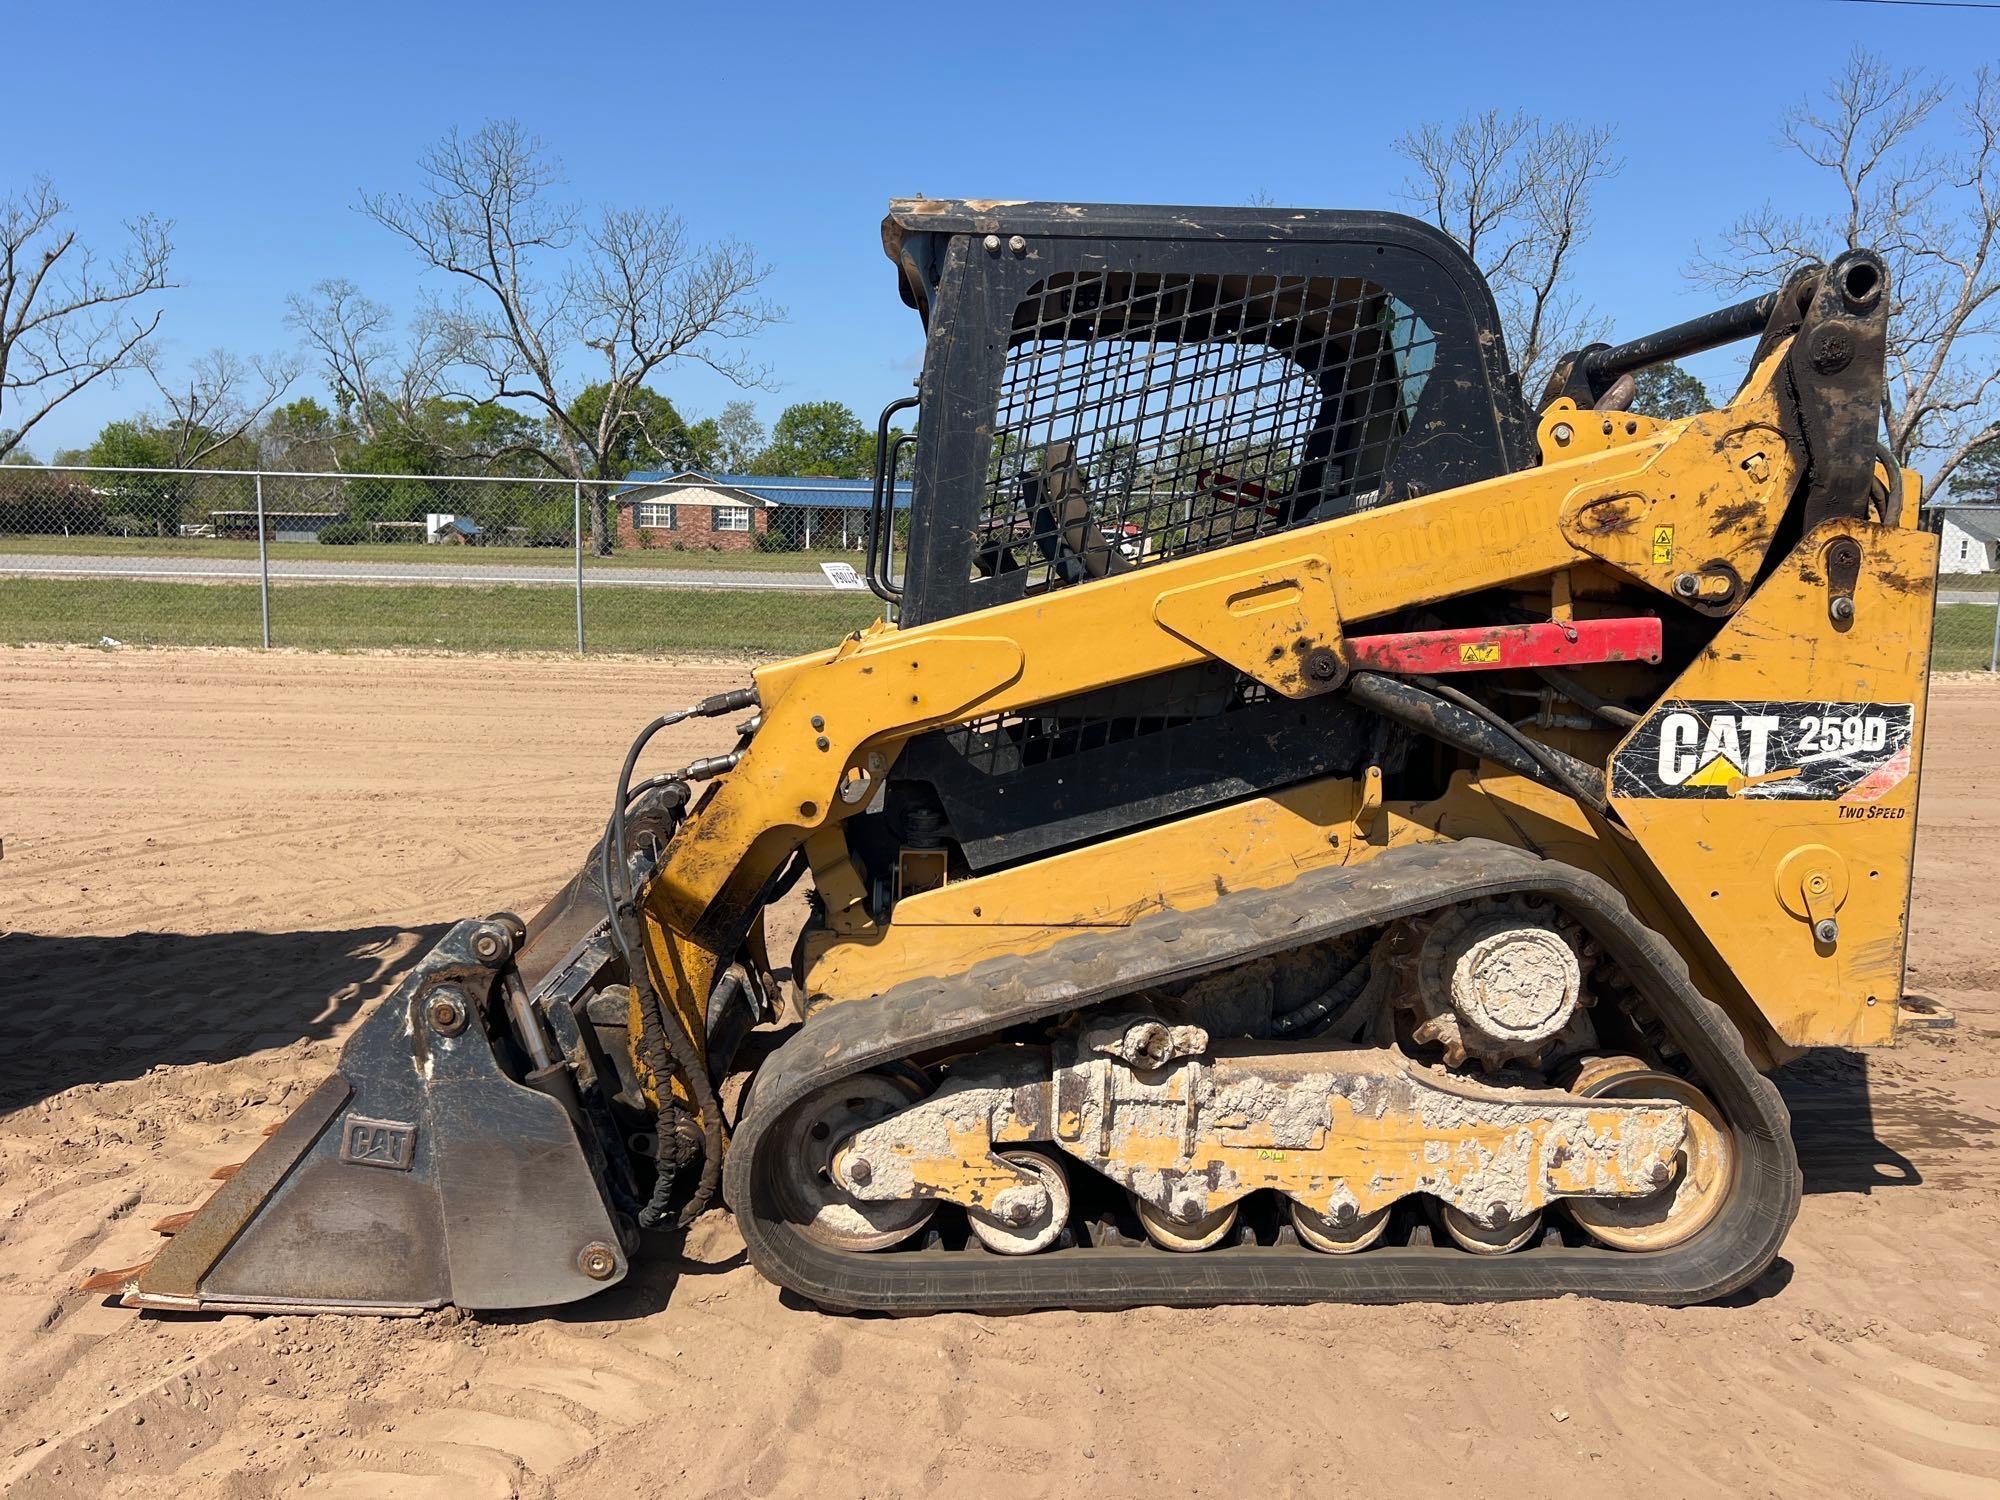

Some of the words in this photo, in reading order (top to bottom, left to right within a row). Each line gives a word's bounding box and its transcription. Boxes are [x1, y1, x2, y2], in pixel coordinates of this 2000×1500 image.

[1658, 713, 1779, 786] CAT
[1799, 716, 1887, 752] 259D
[348, 1123, 410, 1163] CAT
